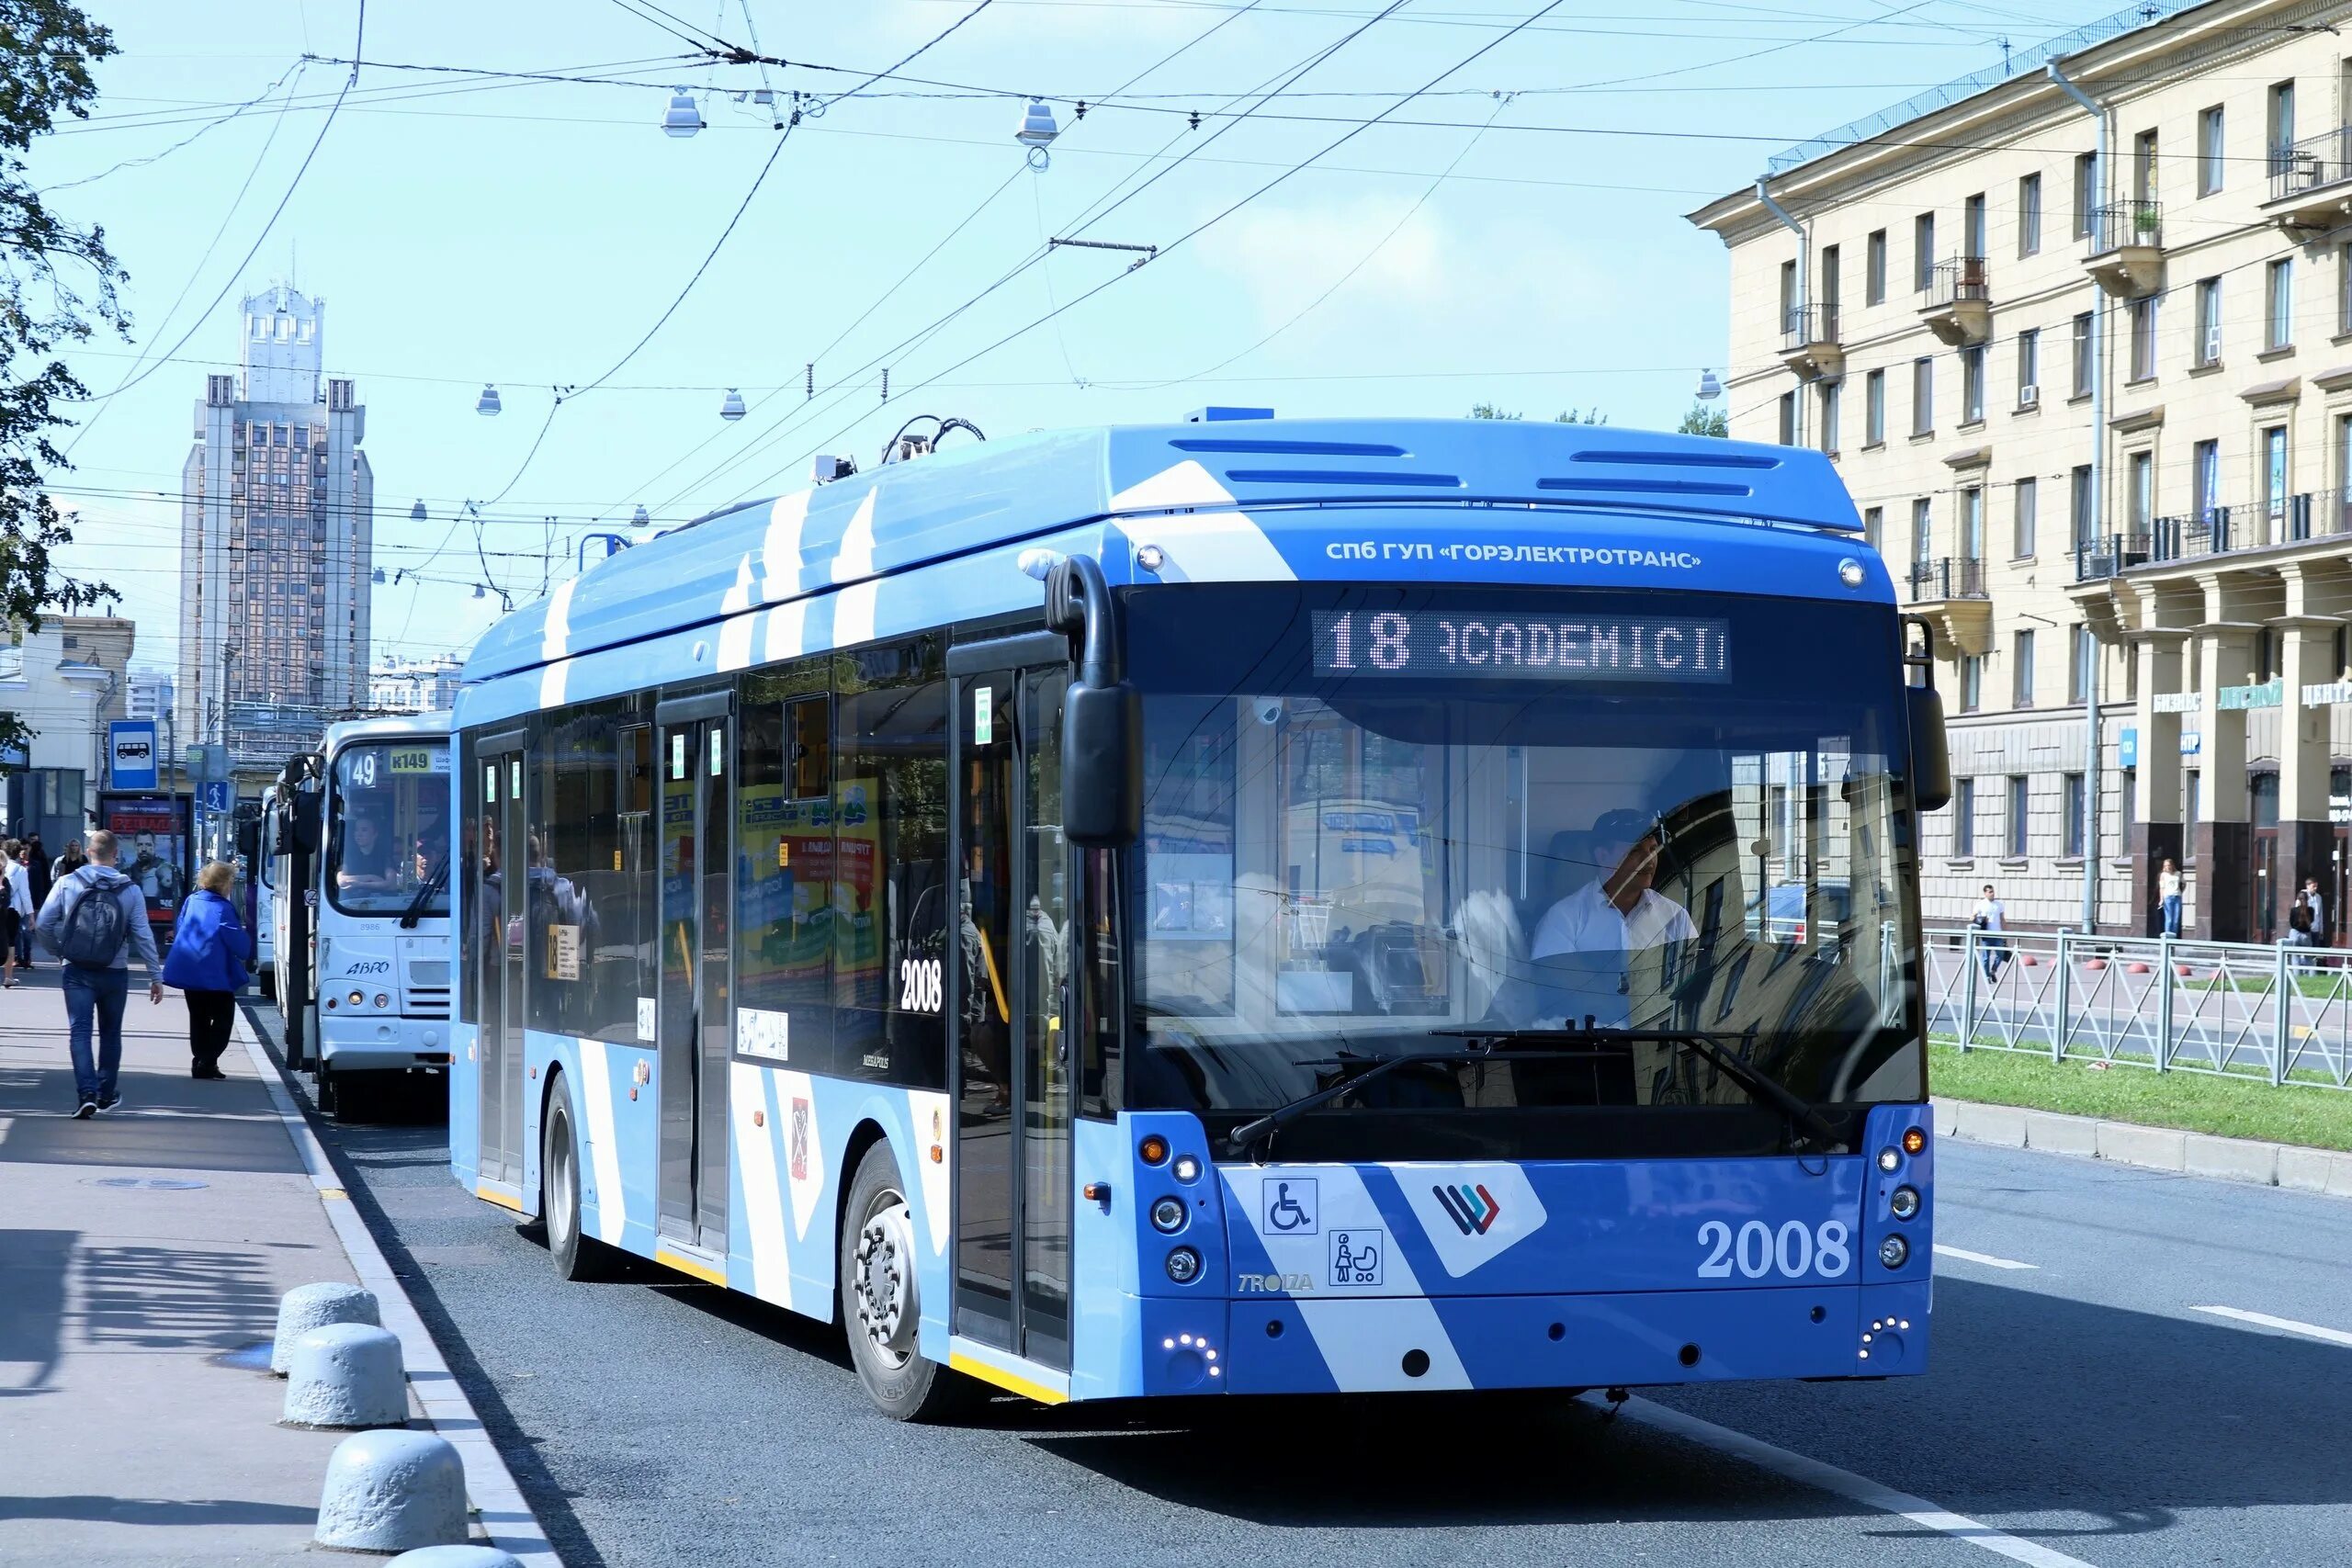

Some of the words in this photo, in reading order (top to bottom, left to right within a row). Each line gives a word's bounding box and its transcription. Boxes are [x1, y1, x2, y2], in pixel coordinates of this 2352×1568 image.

[1326, 541, 1375, 559] СПб
[1383, 543, 1433, 559] ГУП
[1440, 544, 1702, 569] «ГОРЭЛЕКТРОТРАНС»
[1330, 612, 1410, 670] 18
[345, 961, 390, 975] АВРО
[901, 959, 942, 1012] 2008
[1698, 1220, 1850, 1279] 2008
